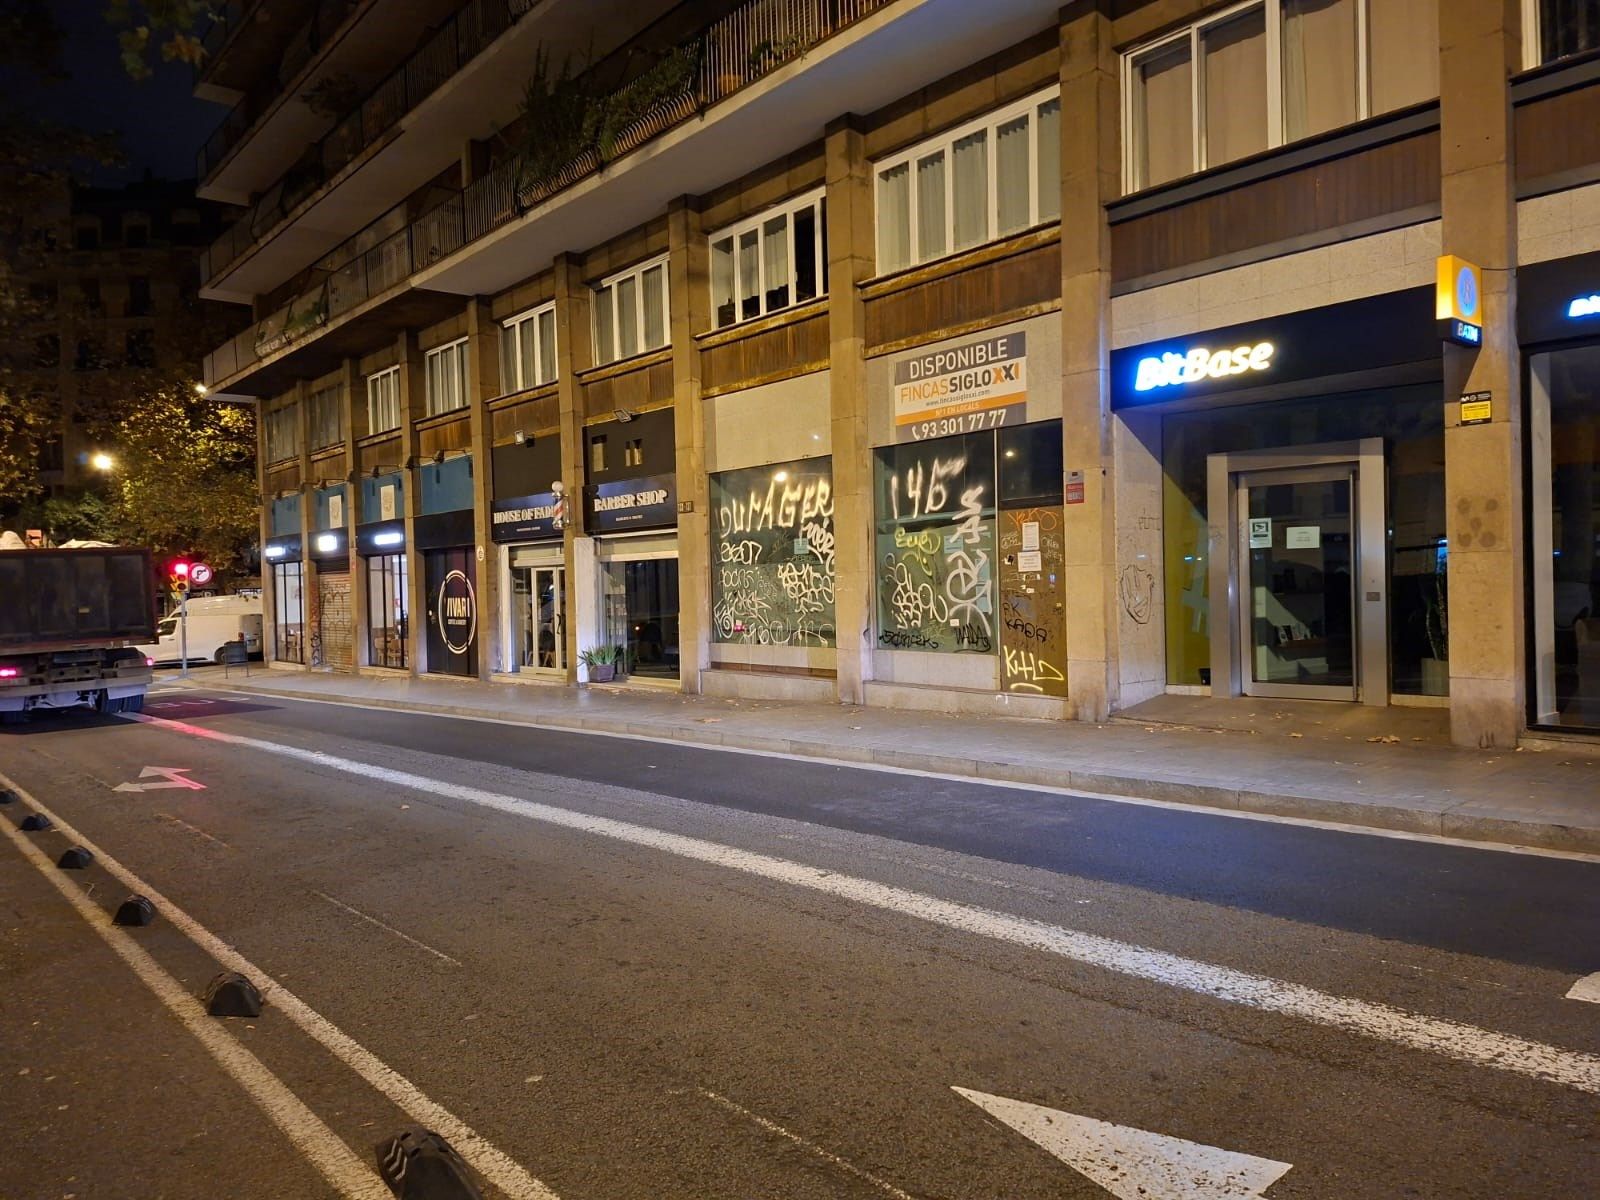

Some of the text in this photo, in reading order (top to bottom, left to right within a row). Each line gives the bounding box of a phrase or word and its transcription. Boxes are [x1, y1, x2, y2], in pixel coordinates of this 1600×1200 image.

[909, 338, 1008, 379] DISPONIBLE
[1134, 342, 1274, 391] BitBase
[921, 408, 1007, 438] 93 301 77 77
[493, 505, 554, 524] HOUSE OF FAD
[593, 489, 668, 512] BARBER SHOP
